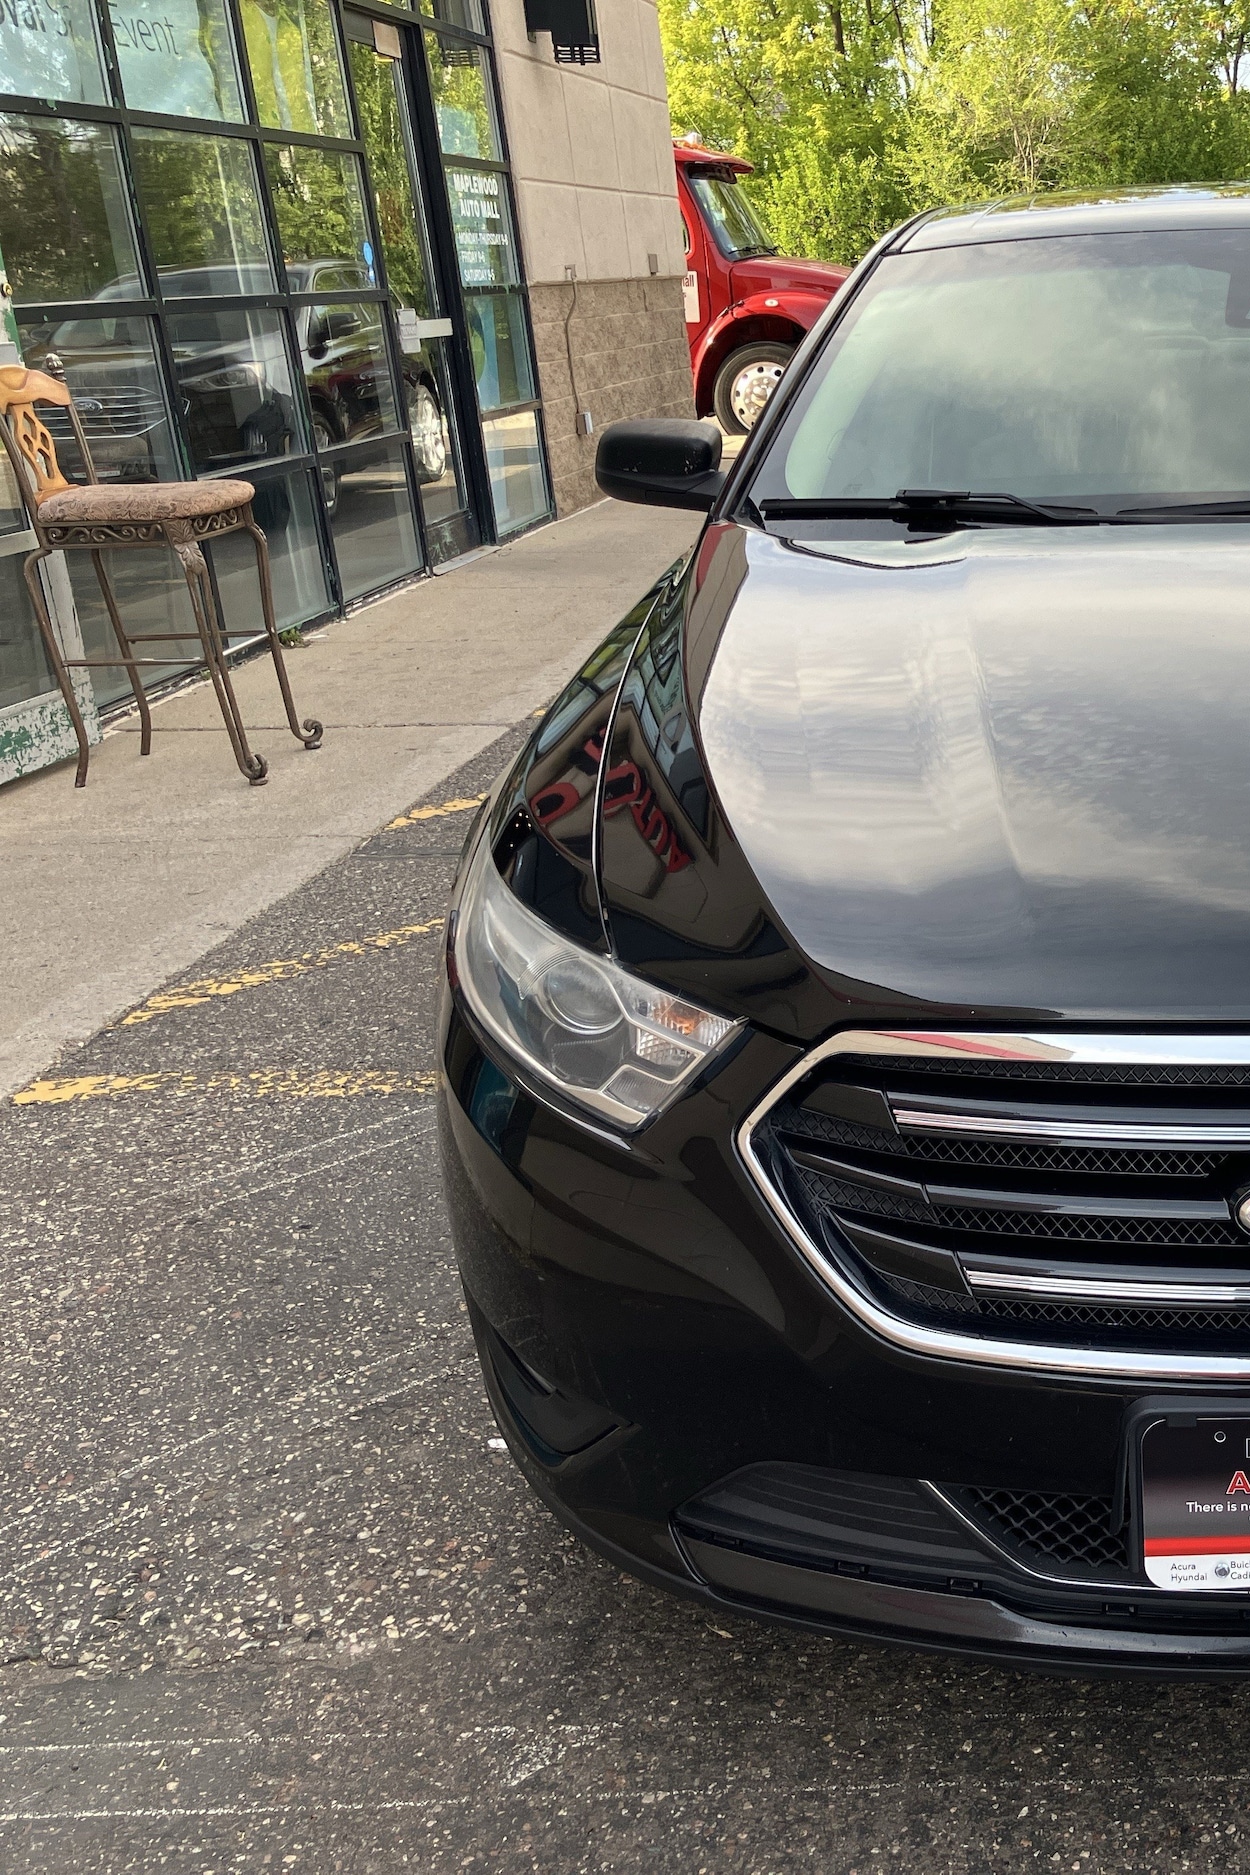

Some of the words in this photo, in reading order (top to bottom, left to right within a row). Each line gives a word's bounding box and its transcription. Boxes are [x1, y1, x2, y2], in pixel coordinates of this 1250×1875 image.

[107, 1, 179, 55] Event
[453, 173, 498, 196] MAPLEWOOD
[460, 199, 481, 218] AUTO
[481, 201, 500, 218] MALL
[464, 269, 488, 281] SATURDAY
[1186, 1501, 1224, 1513] There
[1227, 1501, 1238, 1512] is
[1170, 1563, 1196, 1571] Acura
[1170, 1573, 1208, 1583] Hyundai
